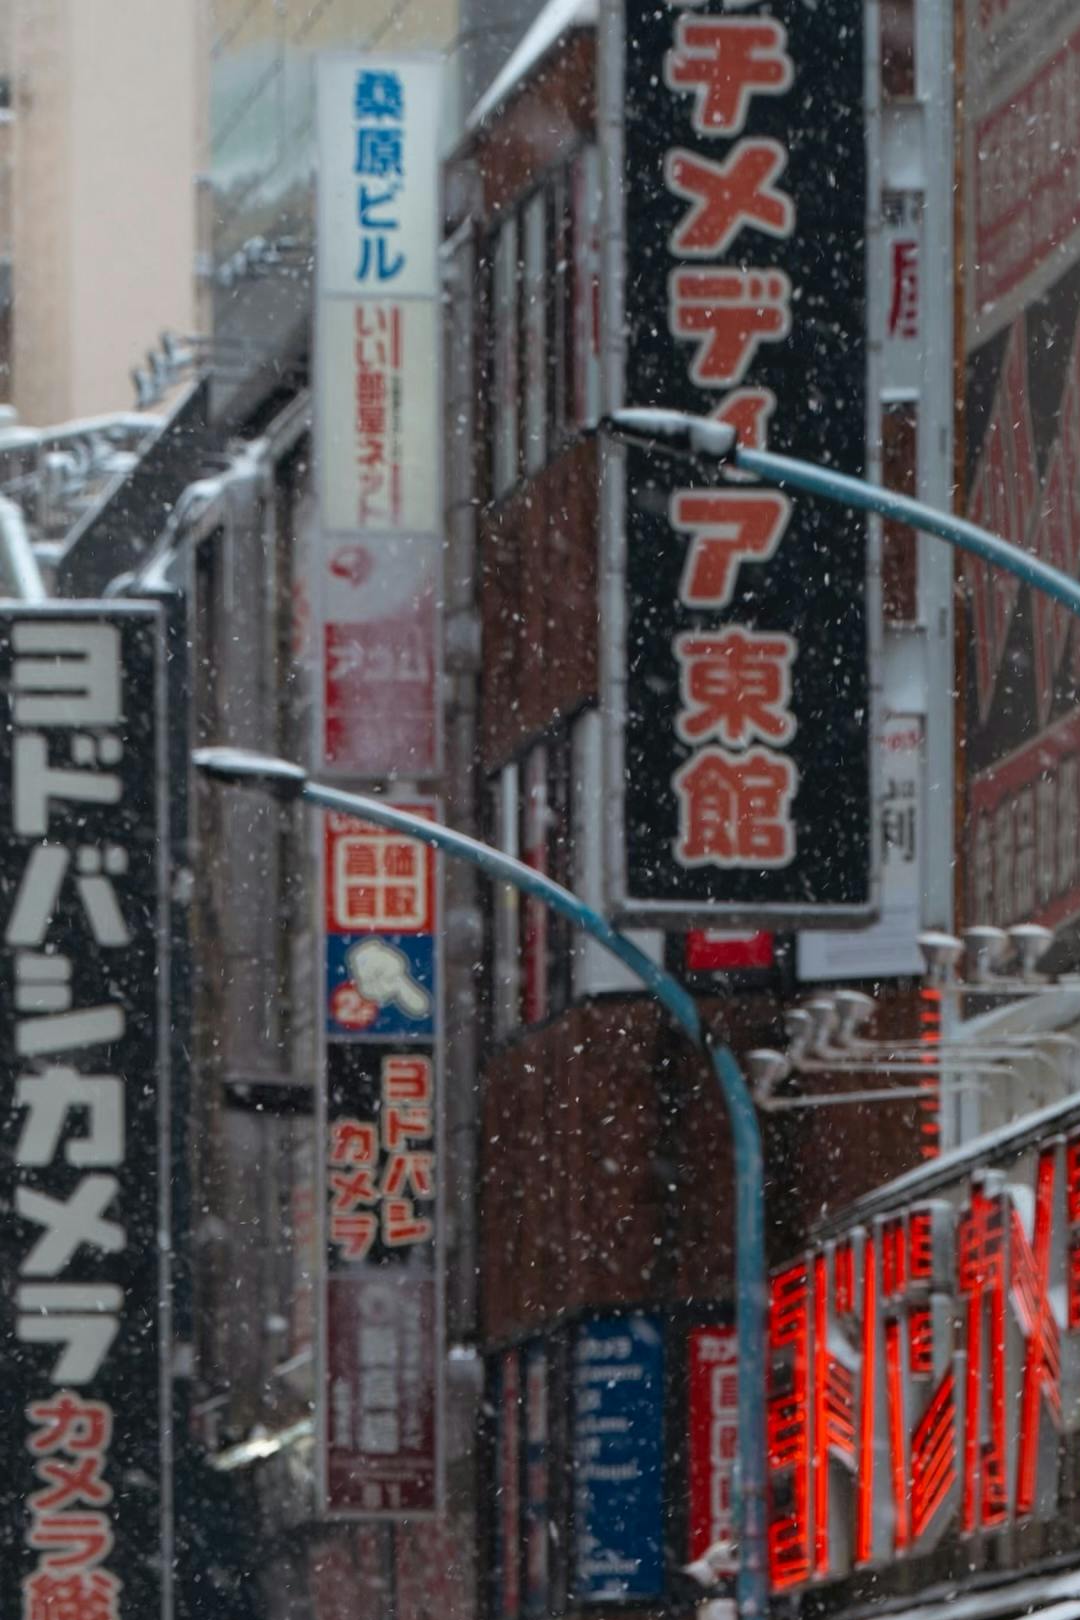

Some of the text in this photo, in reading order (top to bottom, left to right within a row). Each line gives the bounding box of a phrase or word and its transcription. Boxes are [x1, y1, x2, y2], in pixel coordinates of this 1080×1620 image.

[353, 69, 404, 284] 桑原ビル
[5, 621, 130, 1386] ヨドバシカメラ
[329, 1115, 379, 1263] カメラ
[382, 1055, 433, 1246] ヨドバシ
